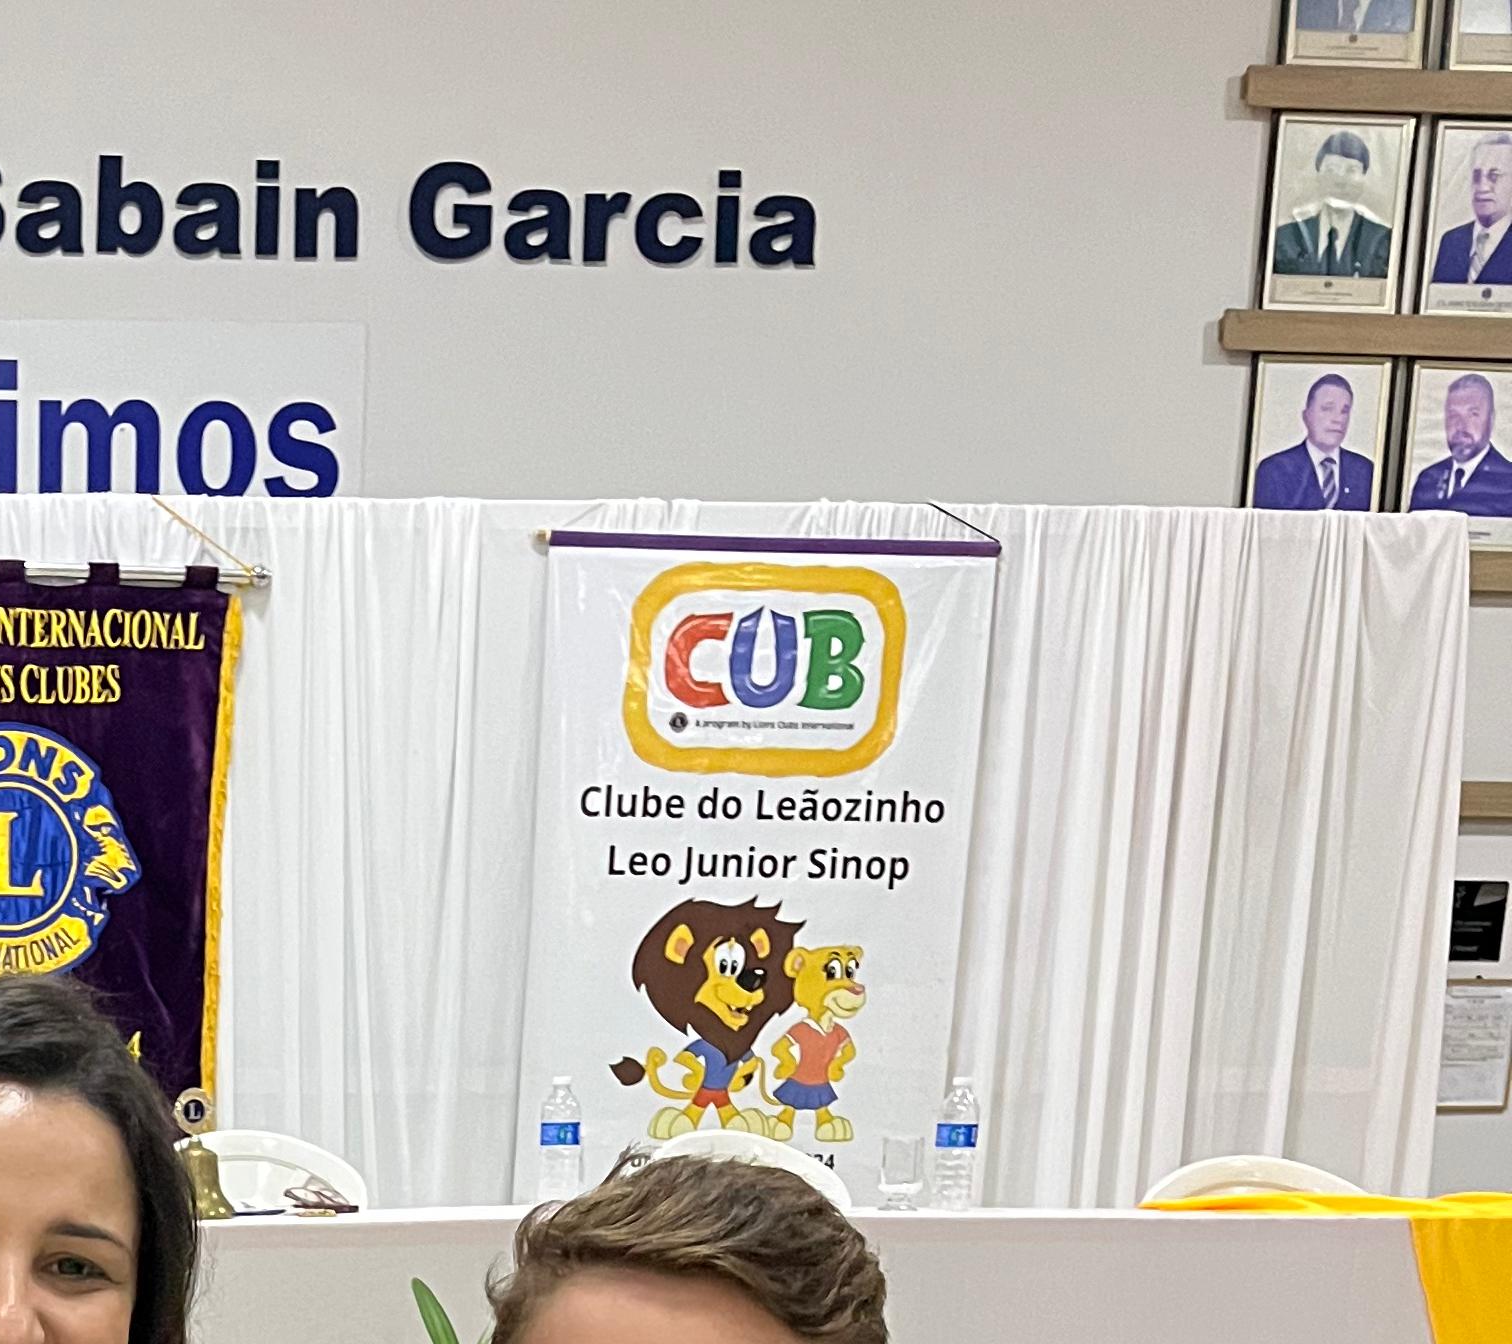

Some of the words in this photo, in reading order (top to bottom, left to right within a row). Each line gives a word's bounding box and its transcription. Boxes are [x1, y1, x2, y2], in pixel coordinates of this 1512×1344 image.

[408, 160, 817, 268] Garcia
[663, 605, 866, 710] CUB
[20, 665, 122, 704] CLUBES
[580, 784, 686, 819] Clube
[698, 787, 742, 819] do
[756, 788, 945, 823] Leãozinho
[608, 845, 672, 877] Leo
[679, 846, 797, 885] Junior
[807, 847, 910, 889] Sinop
